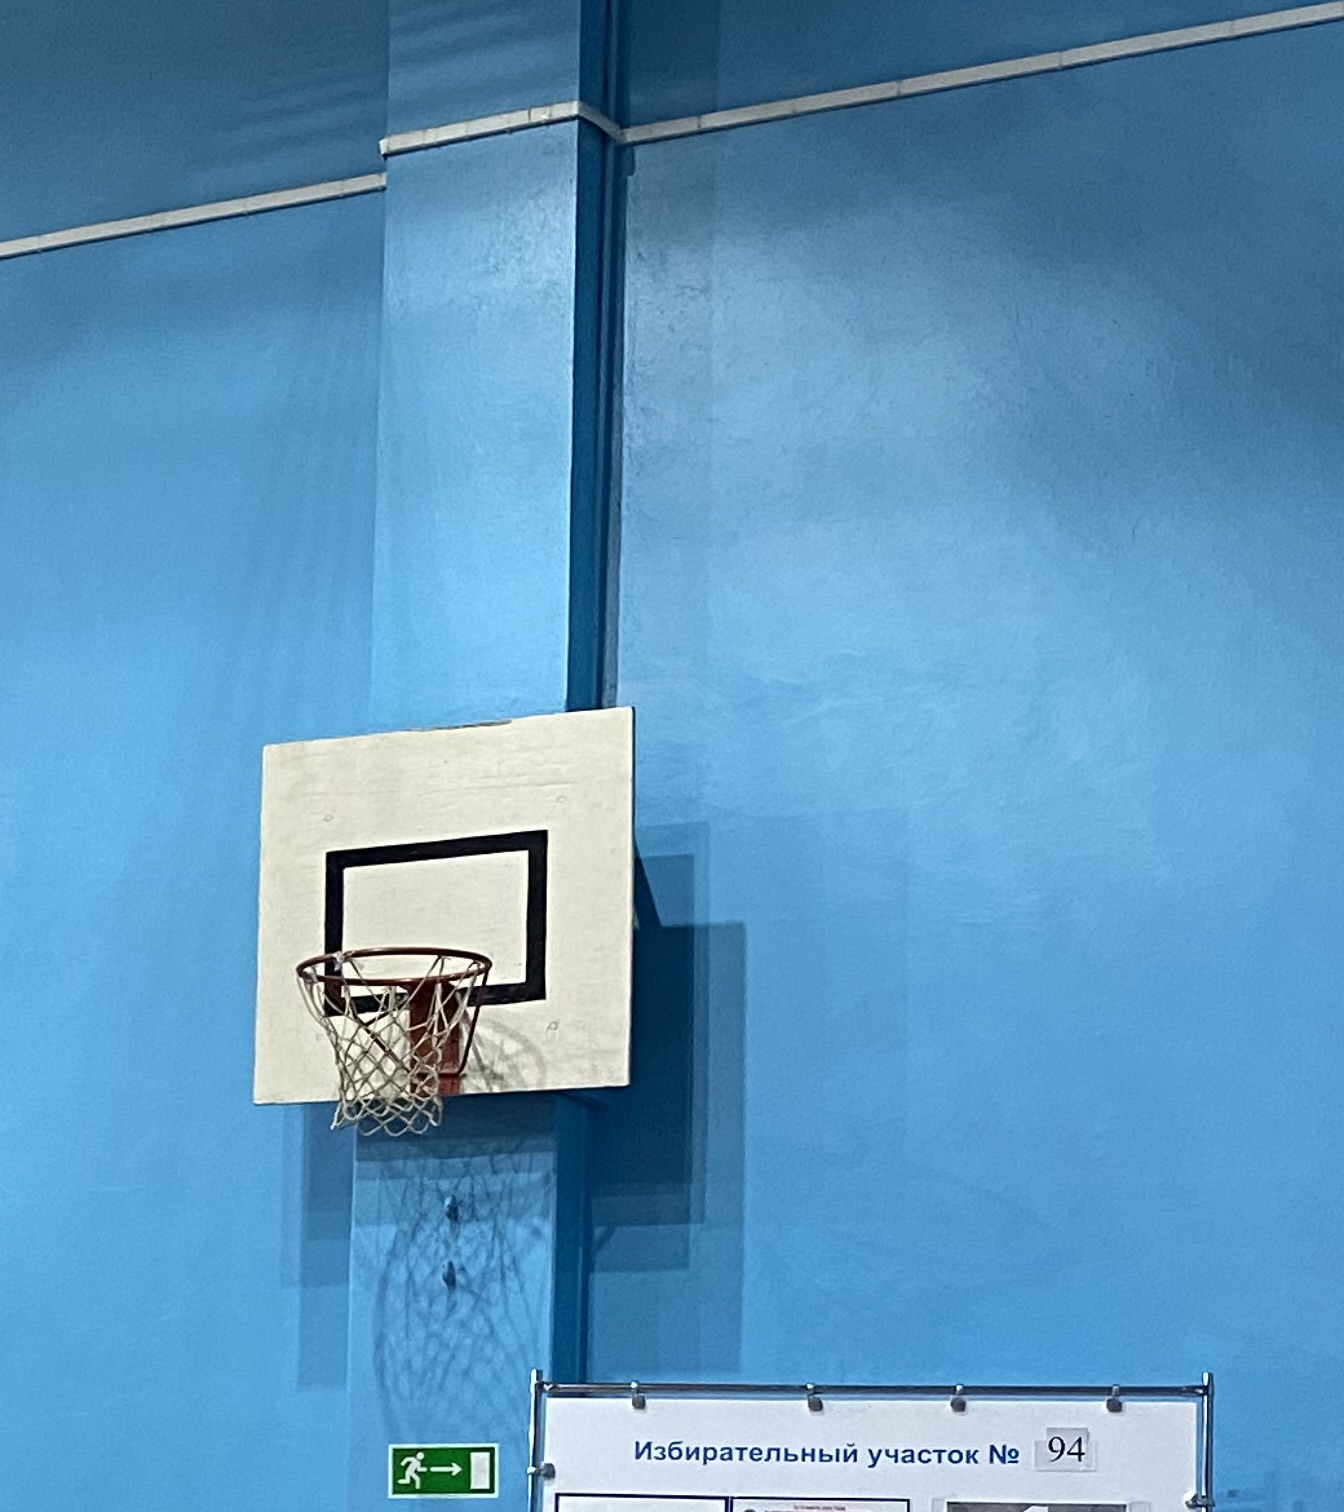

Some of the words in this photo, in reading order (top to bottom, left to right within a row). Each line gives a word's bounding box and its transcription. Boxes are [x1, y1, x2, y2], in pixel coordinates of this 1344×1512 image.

[634, 1440, 859, 1465] Избирательный
[867, 1446, 979, 1469] участок
[988, 1444, 1020, 1465] №
[1047, 1435, 1086, 1463] 94
